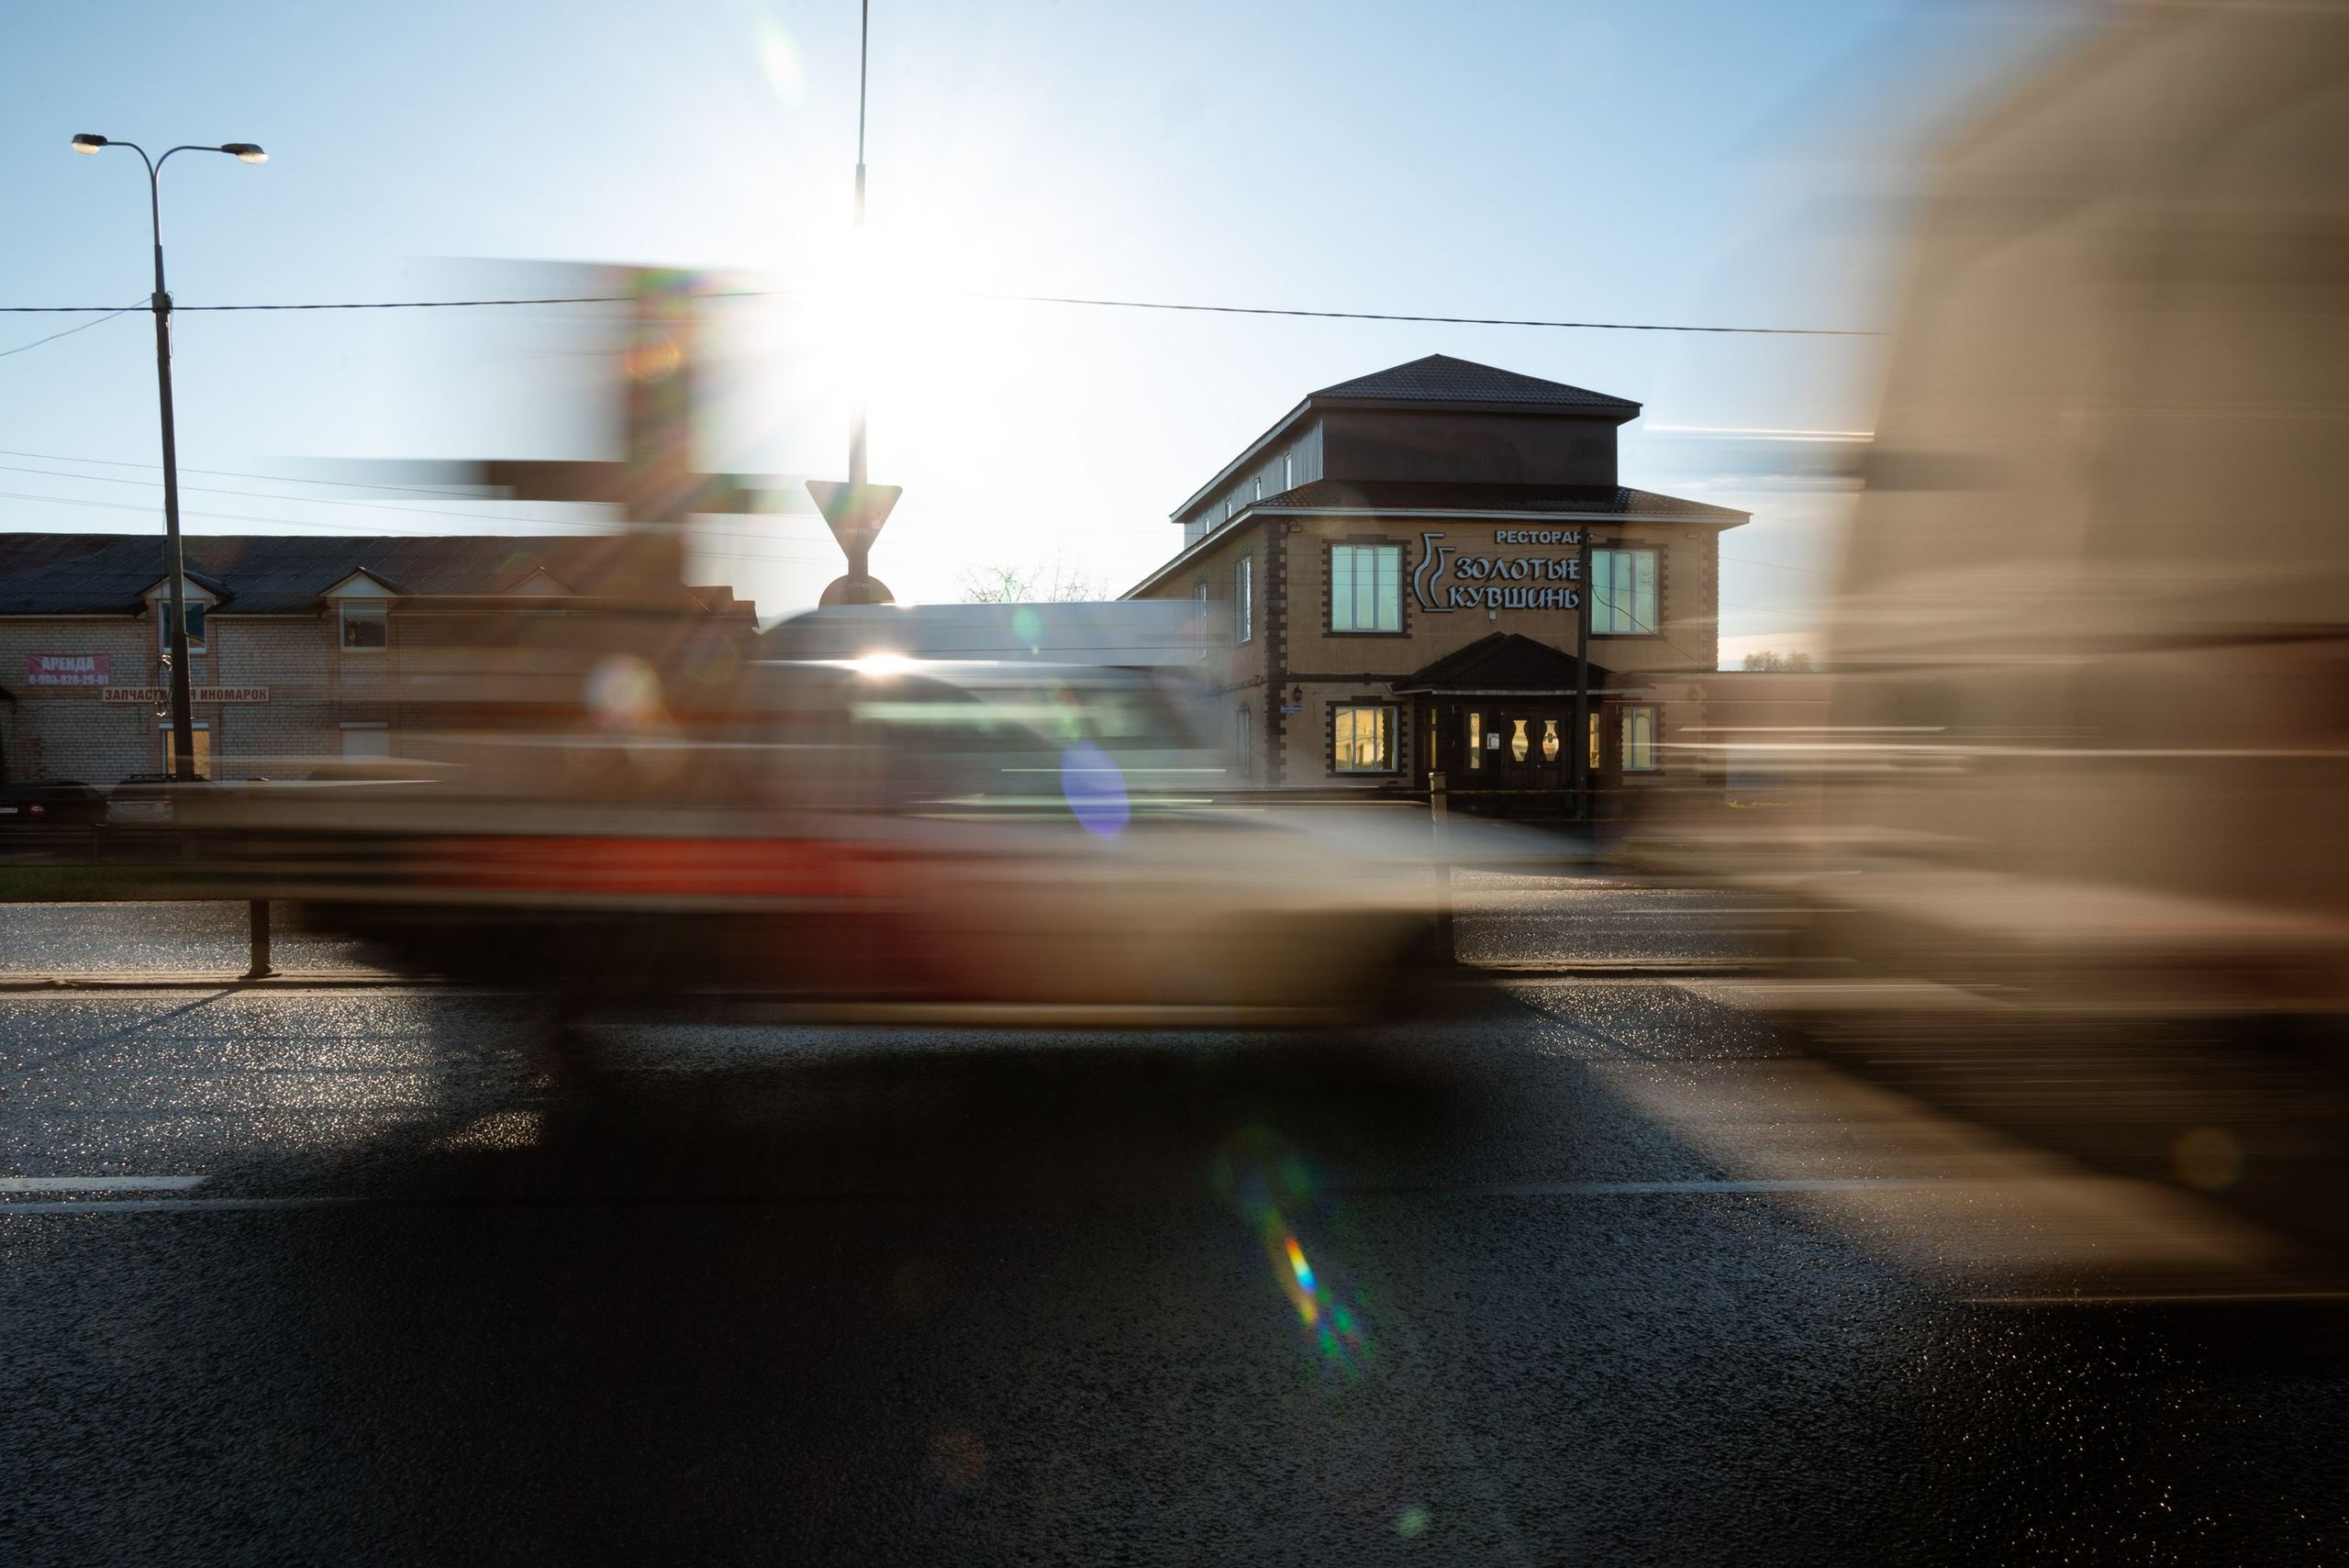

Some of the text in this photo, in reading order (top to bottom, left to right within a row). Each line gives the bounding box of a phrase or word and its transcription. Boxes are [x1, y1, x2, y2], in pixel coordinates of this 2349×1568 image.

[1455, 557, 1580, 580] ЗОЛОТЫЕ
[41, 656, 95, 672] АРЕНДА
[200, 689, 267, 700] ИНОМАРОК
